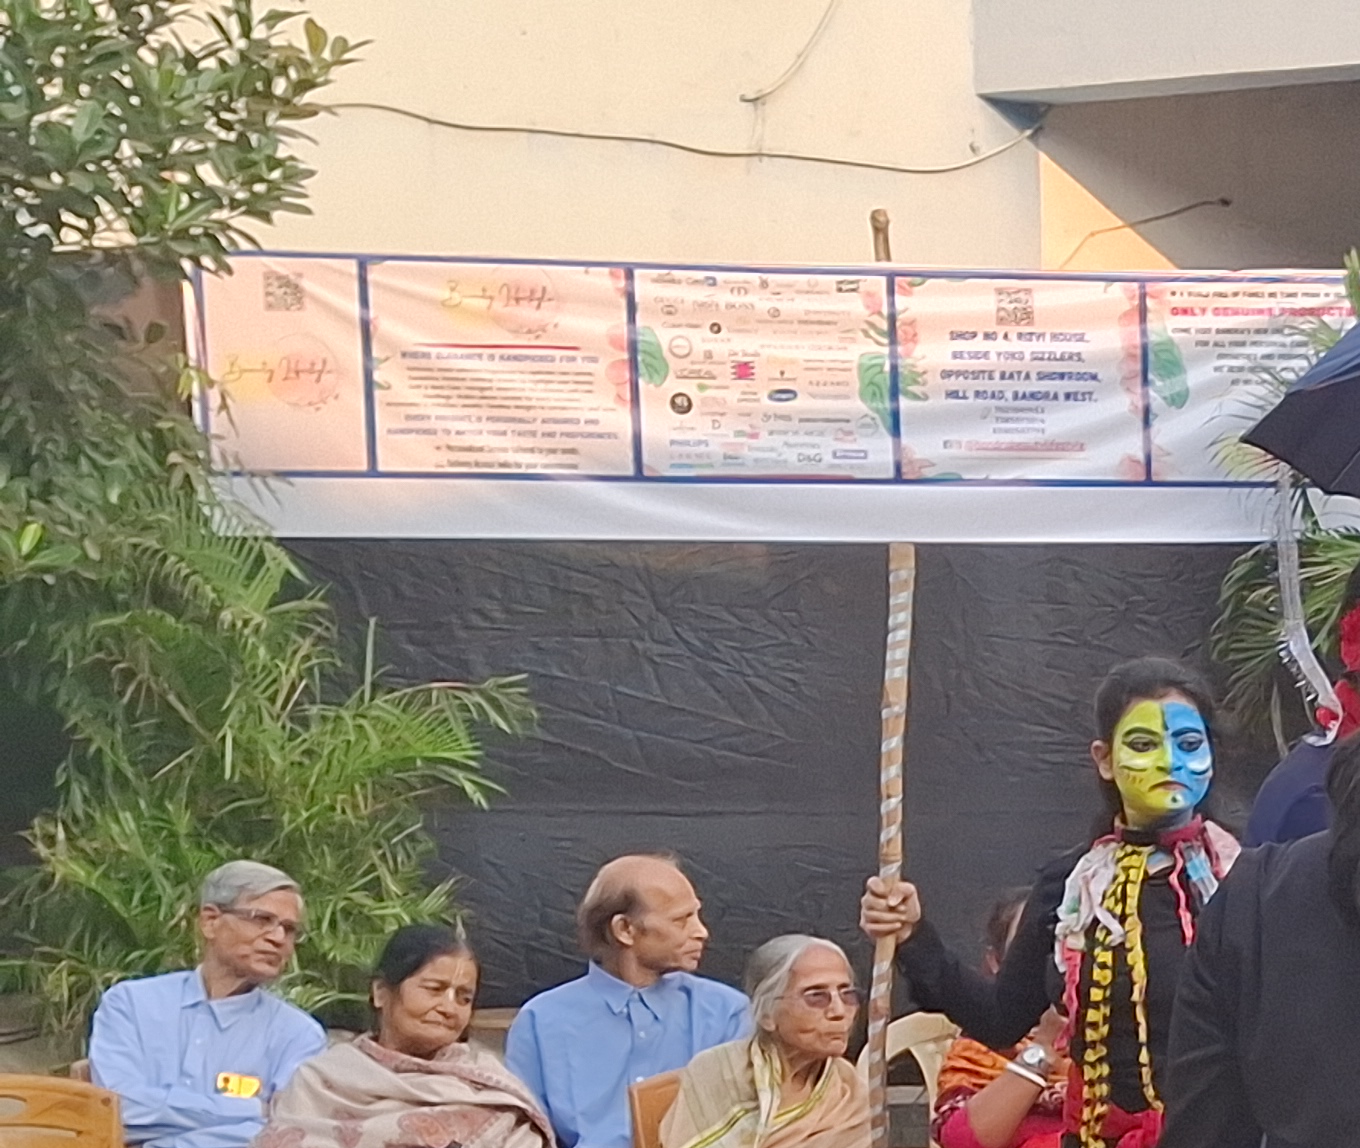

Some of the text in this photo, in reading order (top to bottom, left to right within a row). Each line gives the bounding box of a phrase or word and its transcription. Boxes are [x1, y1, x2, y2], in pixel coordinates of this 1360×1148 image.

[1170, 307, 1206, 317] ONLY
[1212, 307, 1274, 317] GENUINE
[950, 331, 977, 341] SHOP
[983, 331, 997, 341] NO
[940, 369, 995, 380] OPPOSITE
[1000, 370, 1031, 381] BATA
[945, 390, 969, 400] HILL
[1012, 390, 1059, 402] BANDRA
